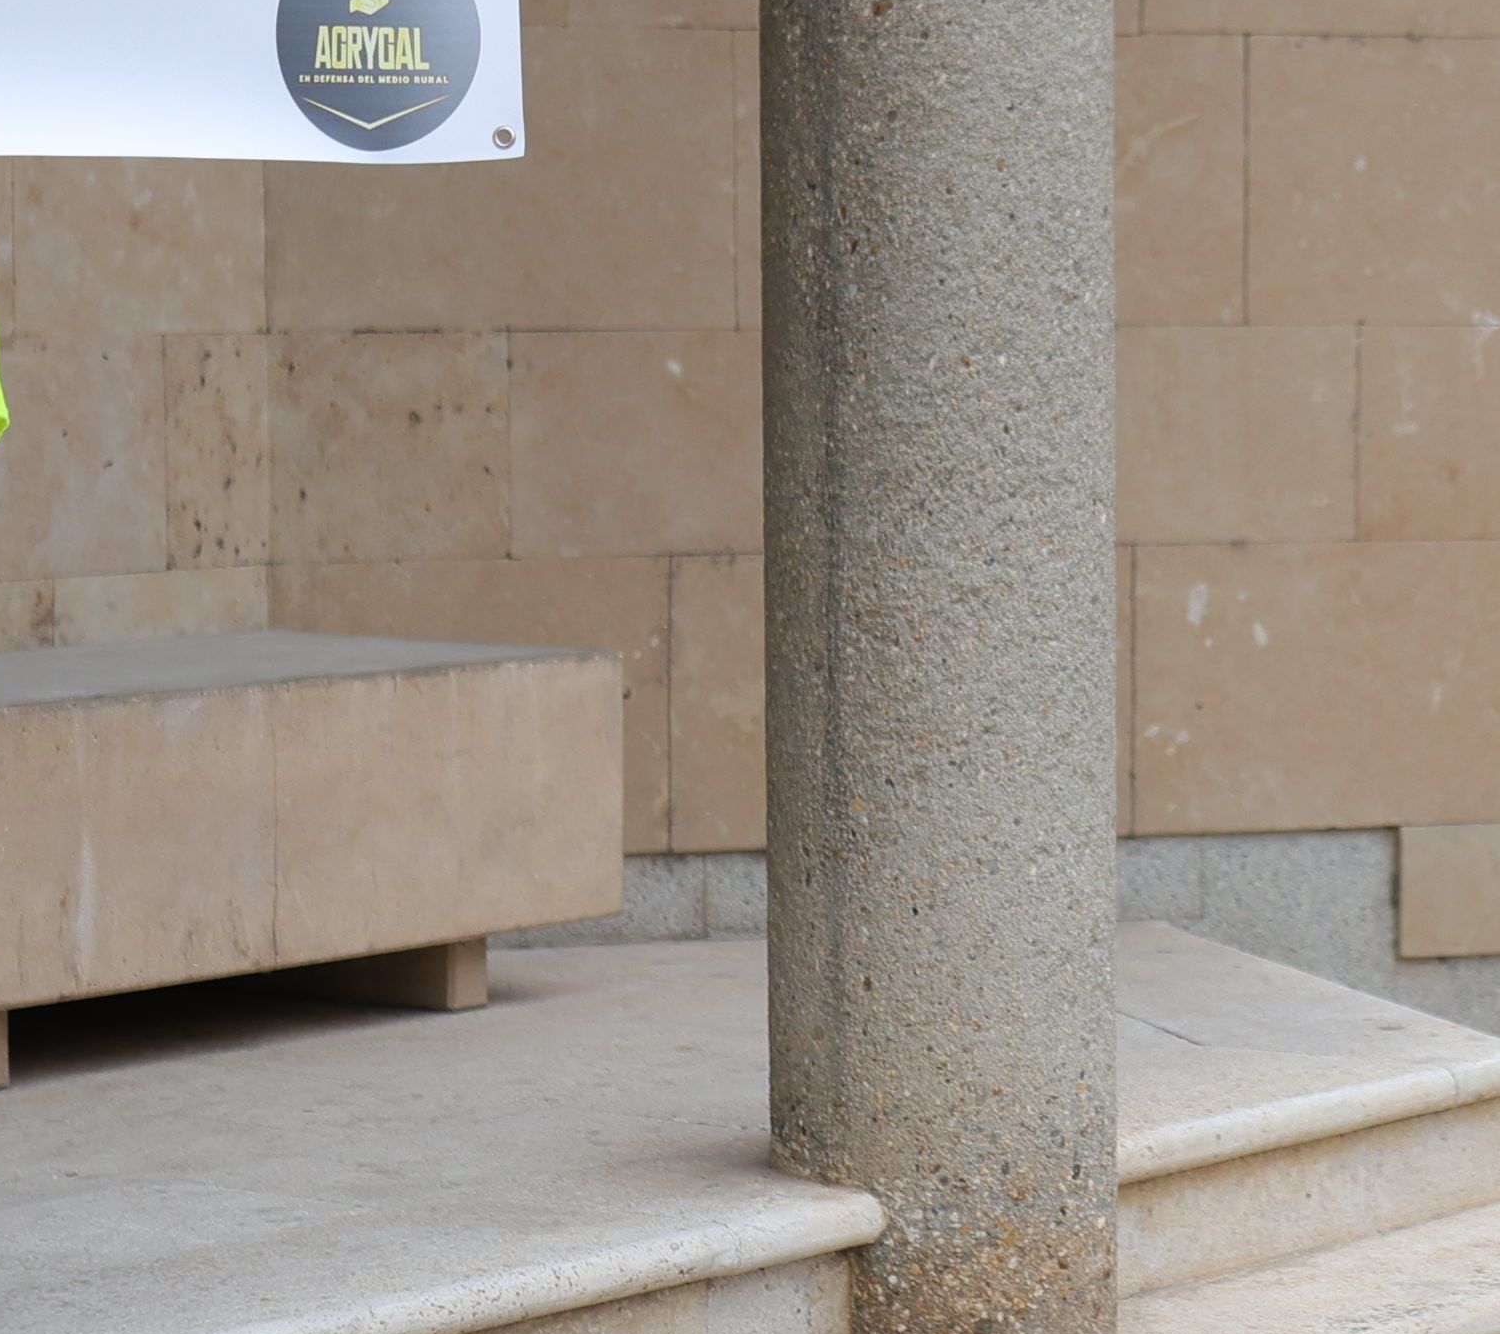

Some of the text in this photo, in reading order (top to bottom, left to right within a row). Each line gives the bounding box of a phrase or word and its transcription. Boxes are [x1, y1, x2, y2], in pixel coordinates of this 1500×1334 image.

[314, 25, 430, 71] AGRYGAL
[299, 74, 449, 84] EN DEFENSA DEL MEDIO RURAL
